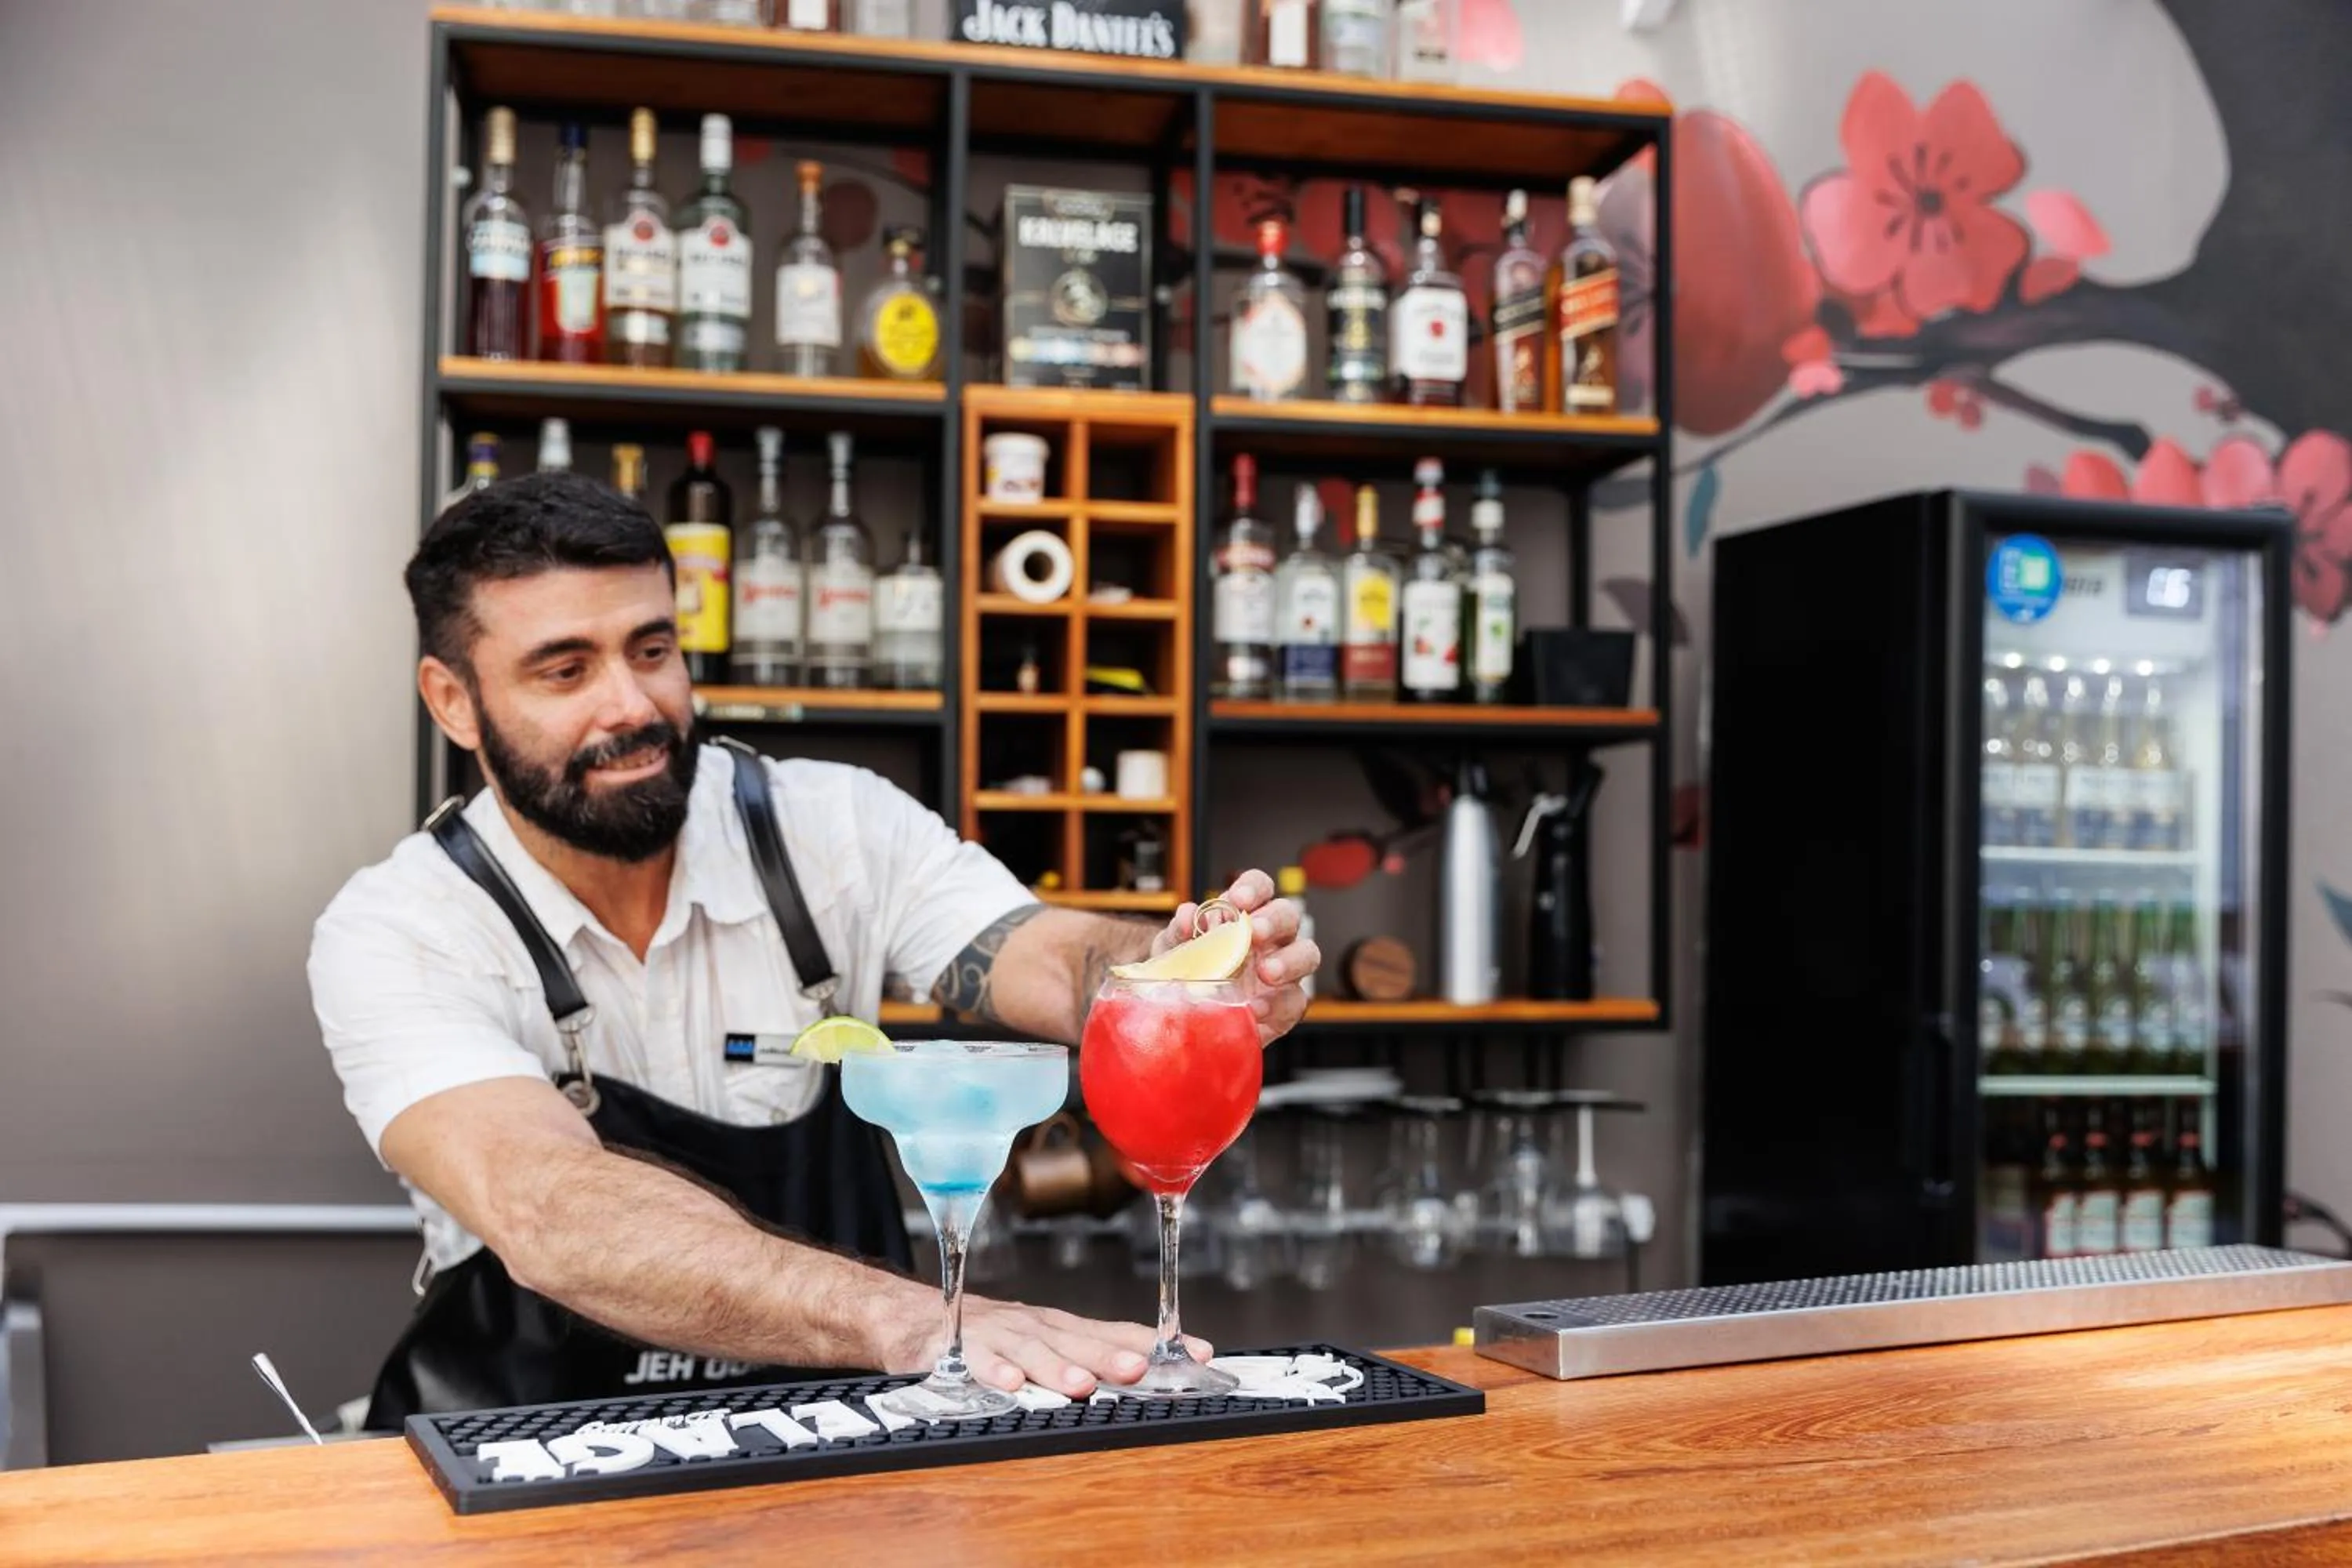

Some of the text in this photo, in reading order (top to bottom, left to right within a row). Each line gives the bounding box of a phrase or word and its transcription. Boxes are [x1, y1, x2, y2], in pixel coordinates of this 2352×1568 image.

[962, 0, 1175, 58] JACK DANIEL'S
[624, 1350, 696, 1385] JEH
